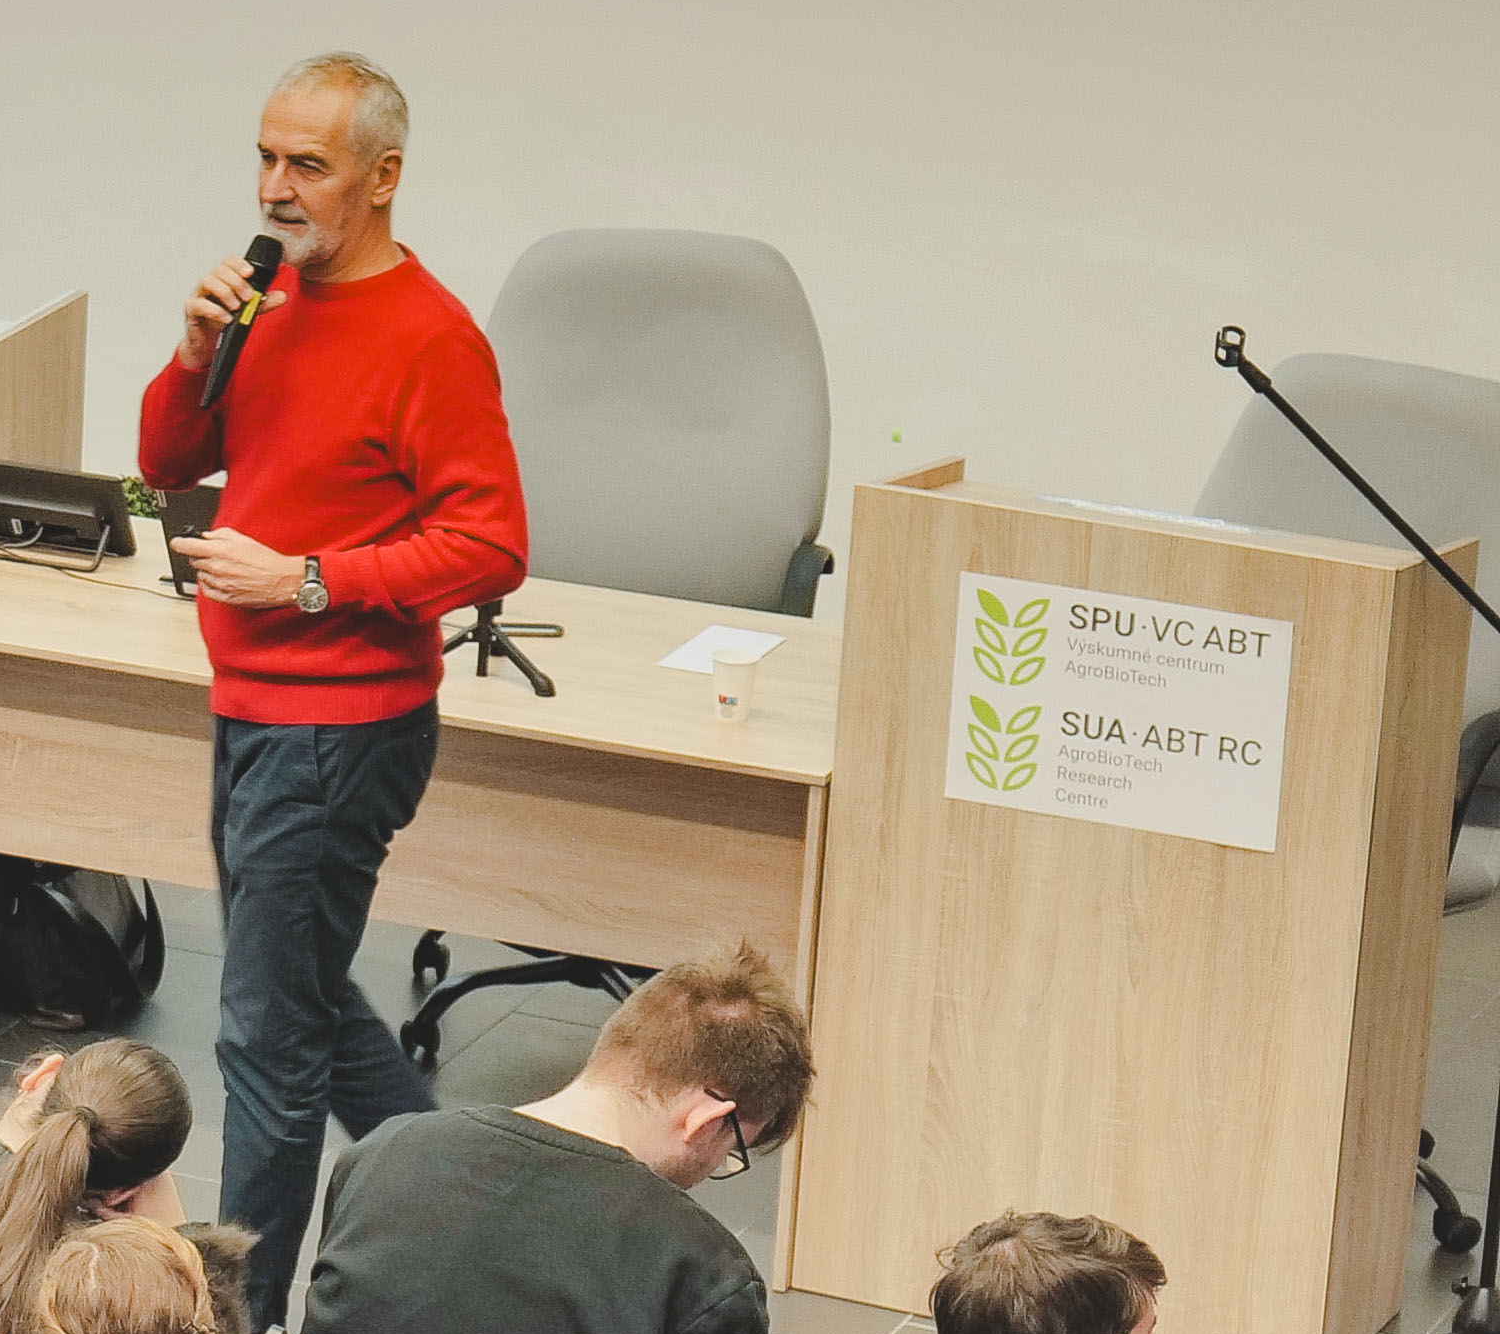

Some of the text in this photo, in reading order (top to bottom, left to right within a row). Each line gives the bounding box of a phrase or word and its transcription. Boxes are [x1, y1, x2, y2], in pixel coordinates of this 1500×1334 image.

[1067, 636, 1224, 674] Výskumné centrum
[1202, 626, 1270, 657] ABT
[1064, 660, 1166, 688] AgroBioTech
[1058, 744, 1162, 772] AgroBioTech
[1218, 736, 1261, 765] RC
[1057, 765, 1131, 790] Research
[1055, 787, 1108, 808] Centre
